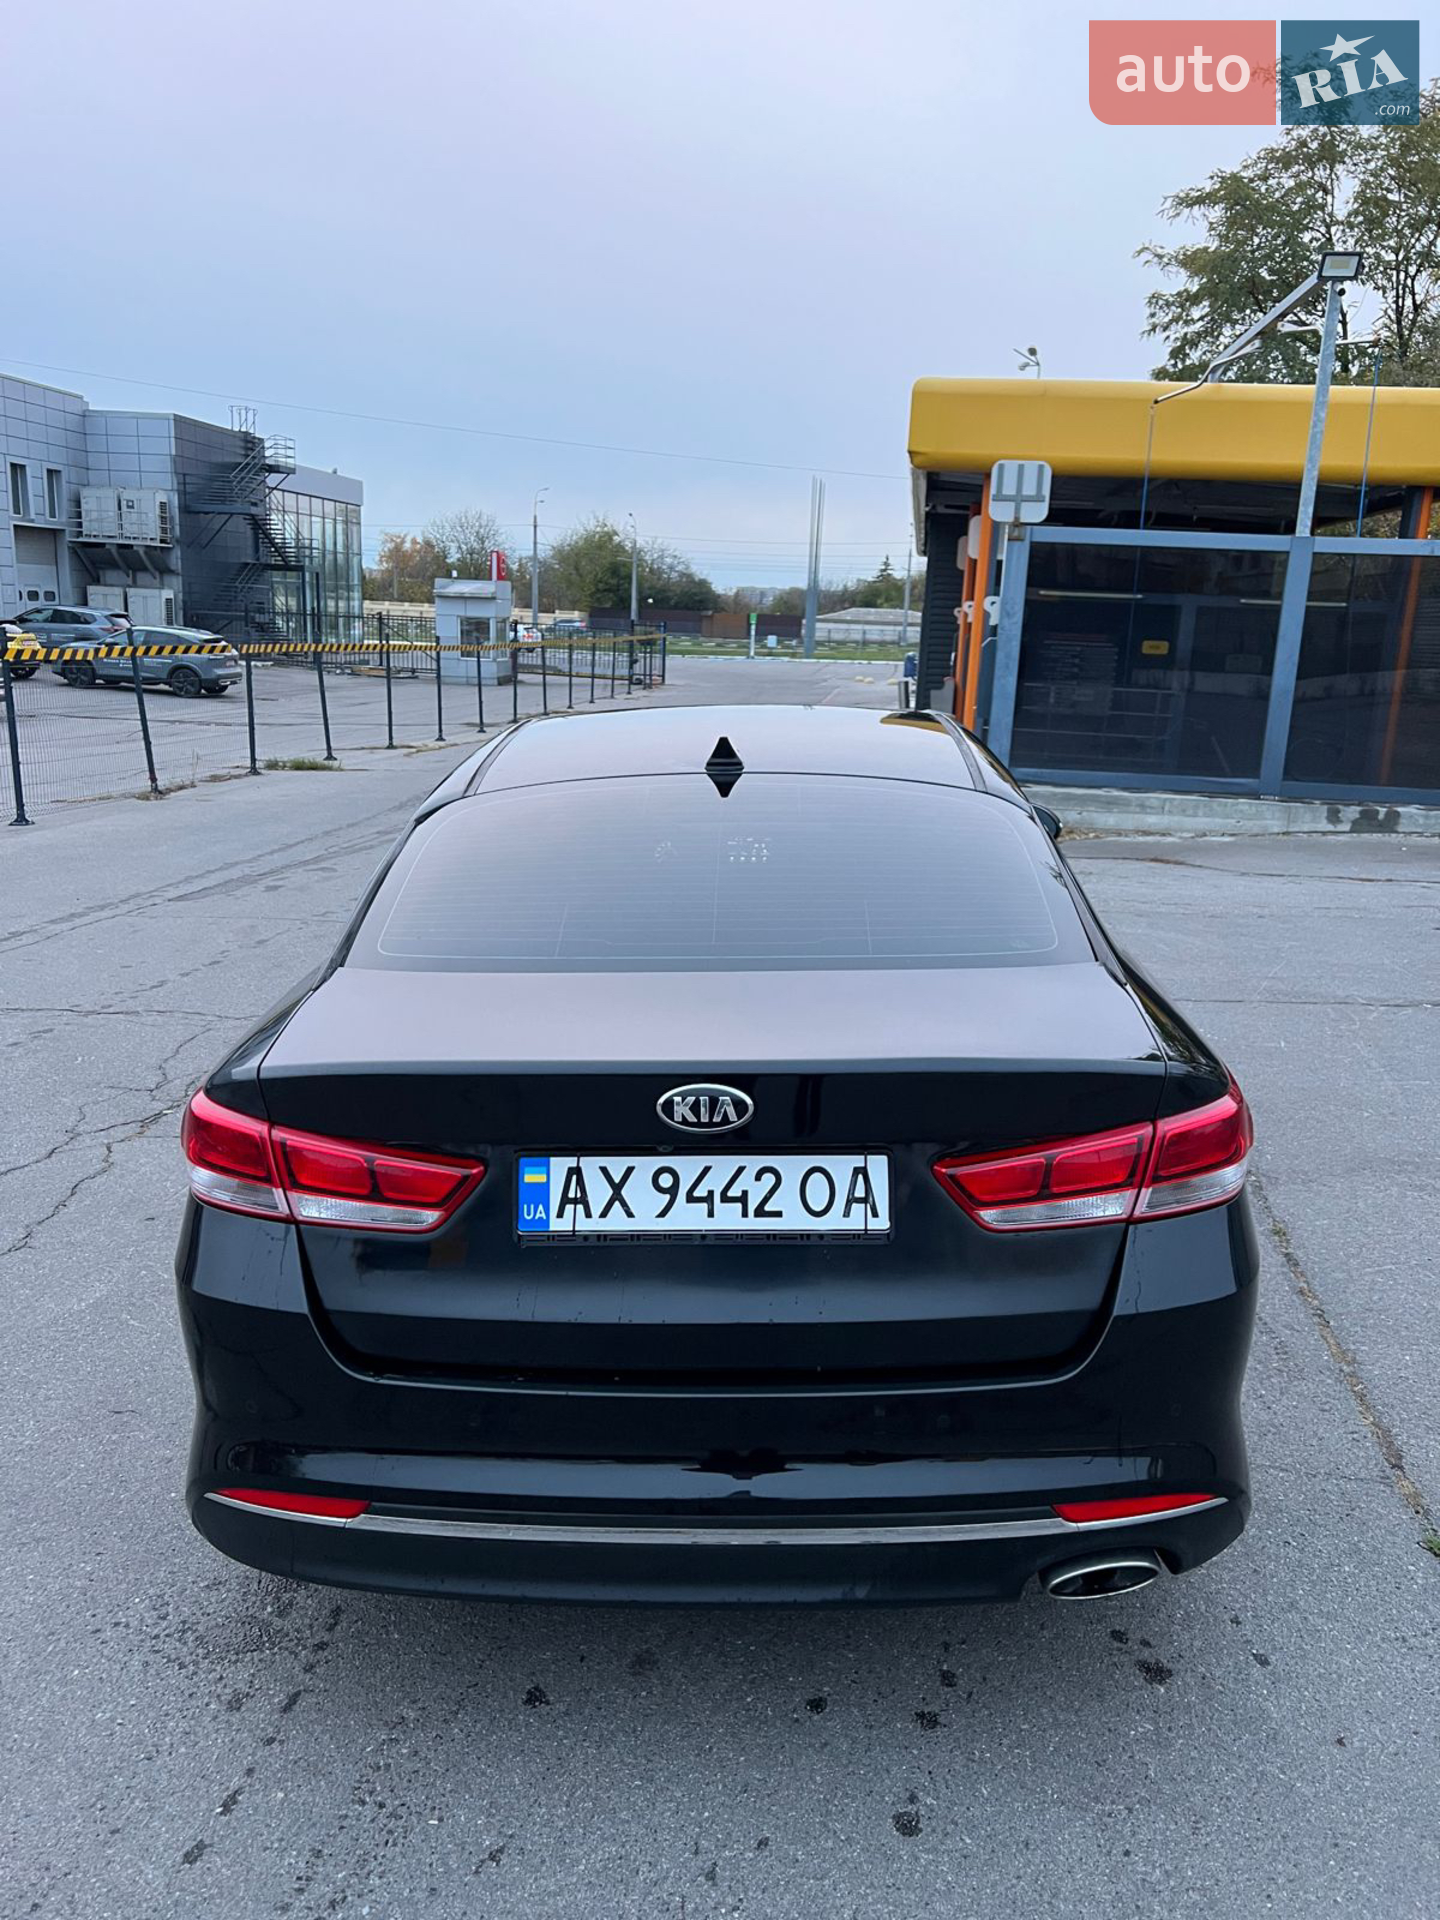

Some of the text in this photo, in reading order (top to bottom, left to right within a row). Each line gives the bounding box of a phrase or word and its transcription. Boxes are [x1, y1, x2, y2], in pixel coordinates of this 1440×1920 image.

[672, 1096, 738, 1122] KIA
[555, 1165, 880, 1219] AX 9442 OA
[523, 1204, 547, 1221] UA
